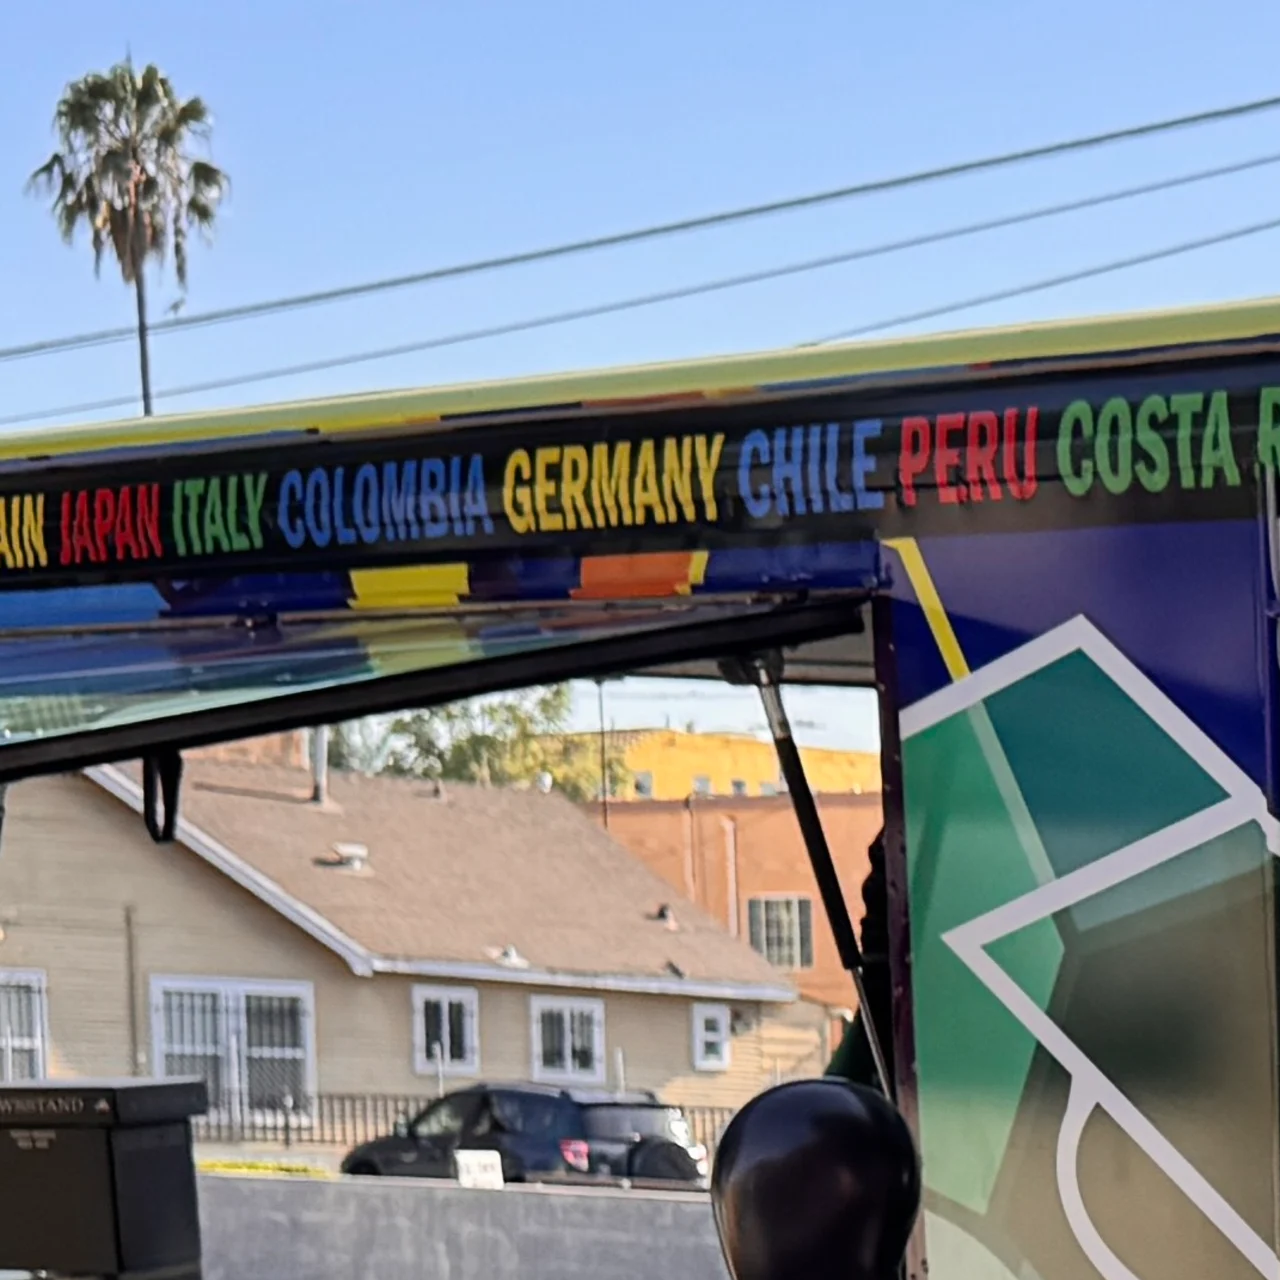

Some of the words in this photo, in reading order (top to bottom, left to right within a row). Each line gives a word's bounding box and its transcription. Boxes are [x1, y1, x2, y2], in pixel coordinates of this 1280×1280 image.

[60, 483, 163, 565] JAPAN
[172, 472, 268, 557] ITALY
[278, 453, 494, 548] COLOMBIA
[503, 433, 725, 533] GERMANY
[737, 419, 885, 518] CHILE
[899, 406, 1038, 505] PERU
[1057, 390, 1240, 496] COSTA
